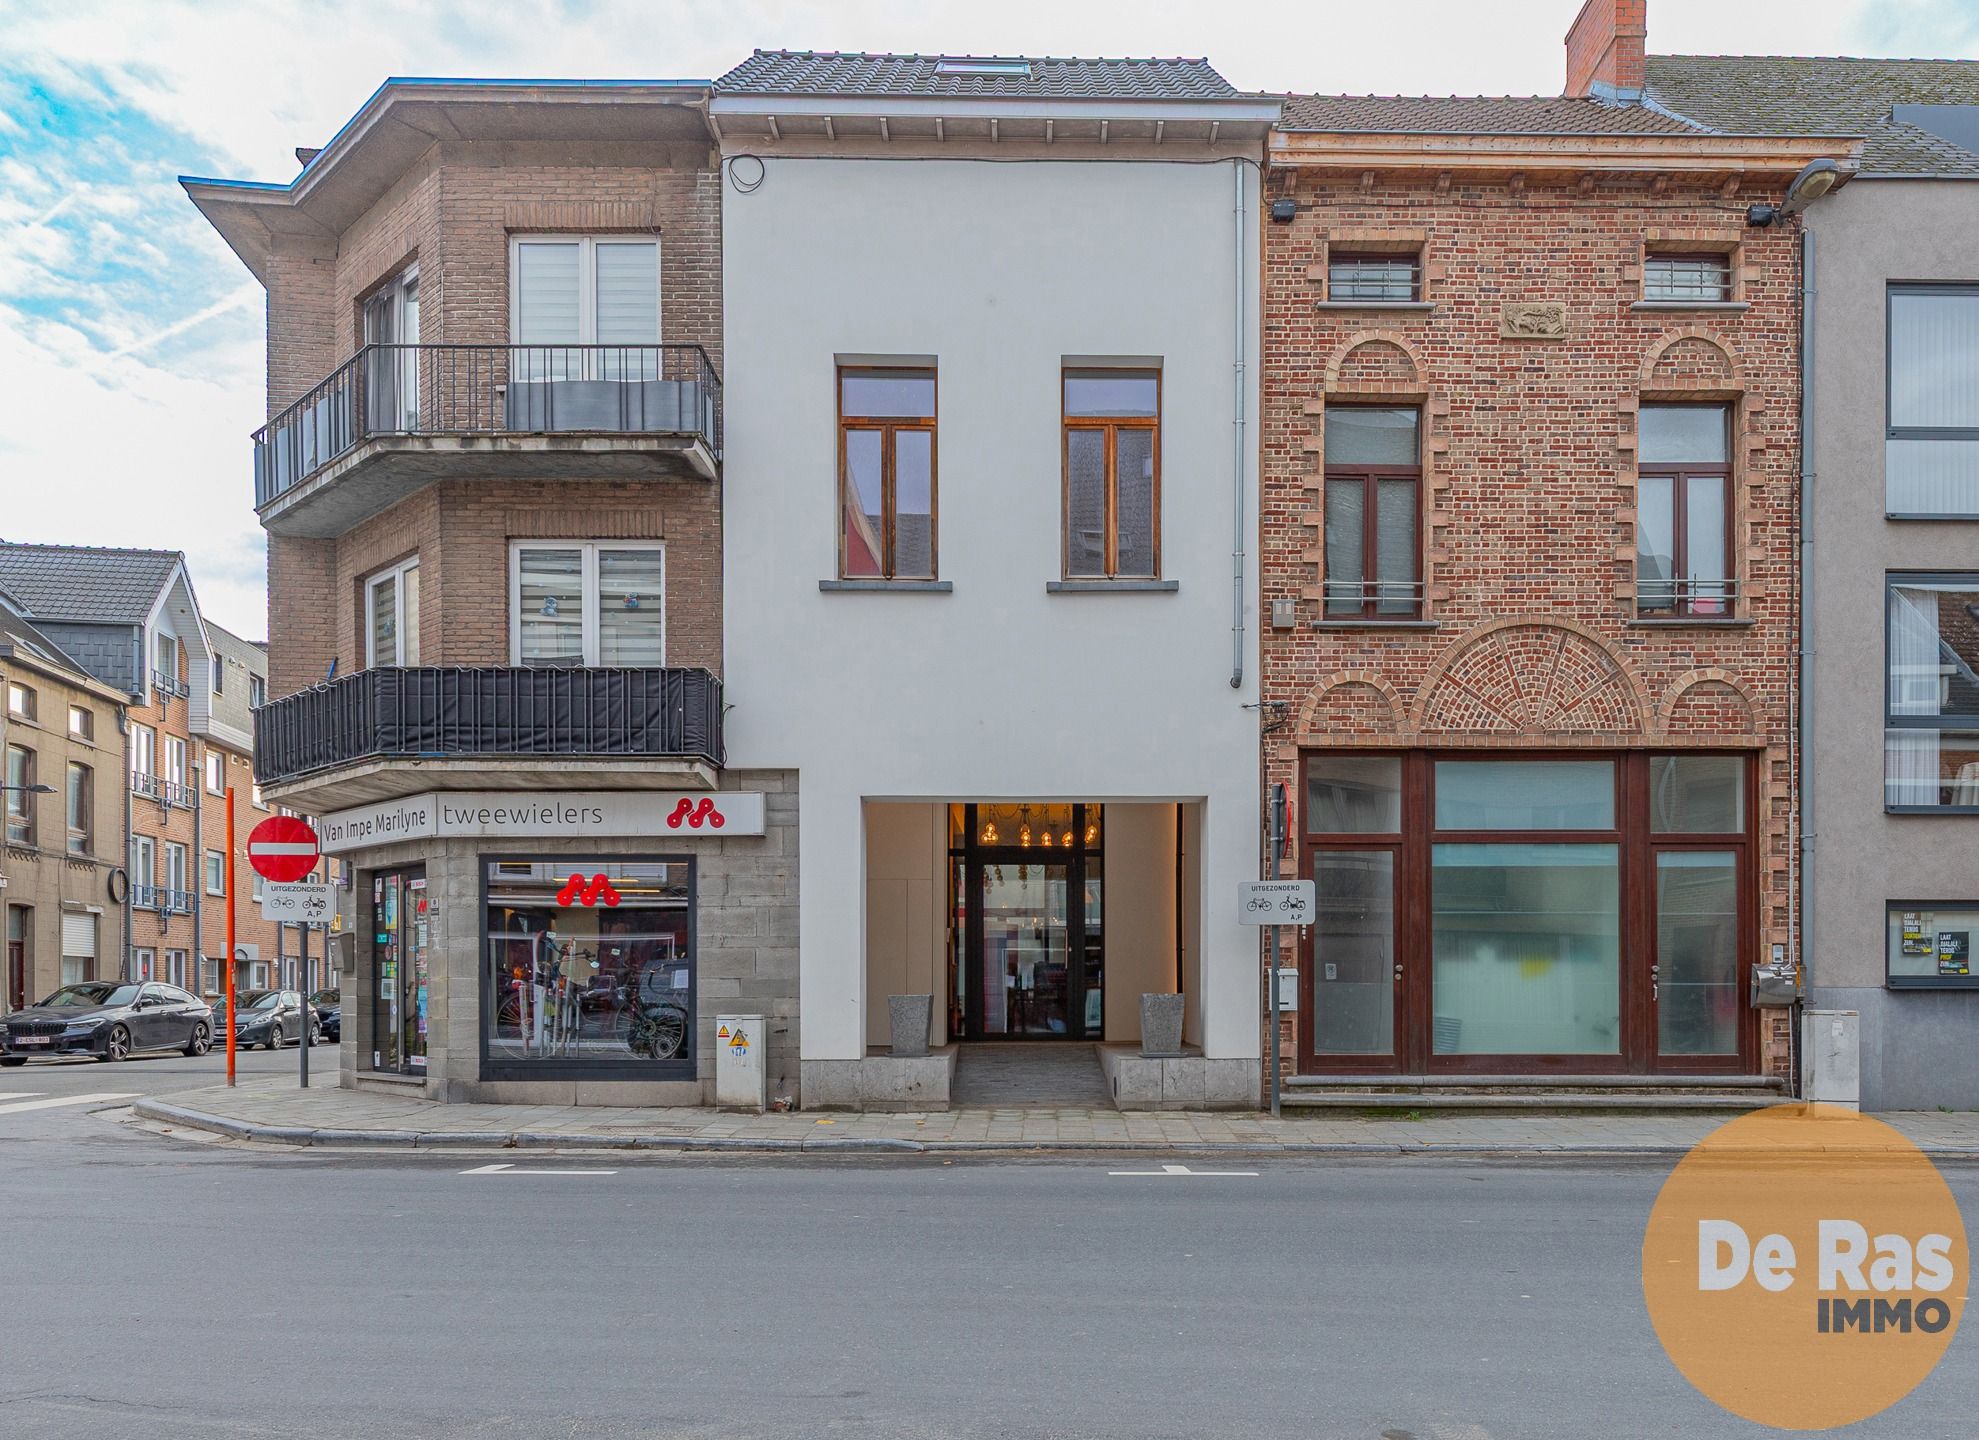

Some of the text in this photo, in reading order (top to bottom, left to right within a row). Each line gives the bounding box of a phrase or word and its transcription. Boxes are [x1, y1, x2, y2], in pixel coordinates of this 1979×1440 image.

[324, 807, 426, 842] Van Impe Marilyne
[443, 802, 603, 825] tweewielers
[271, 885, 326, 893] UITGEZONDERD
